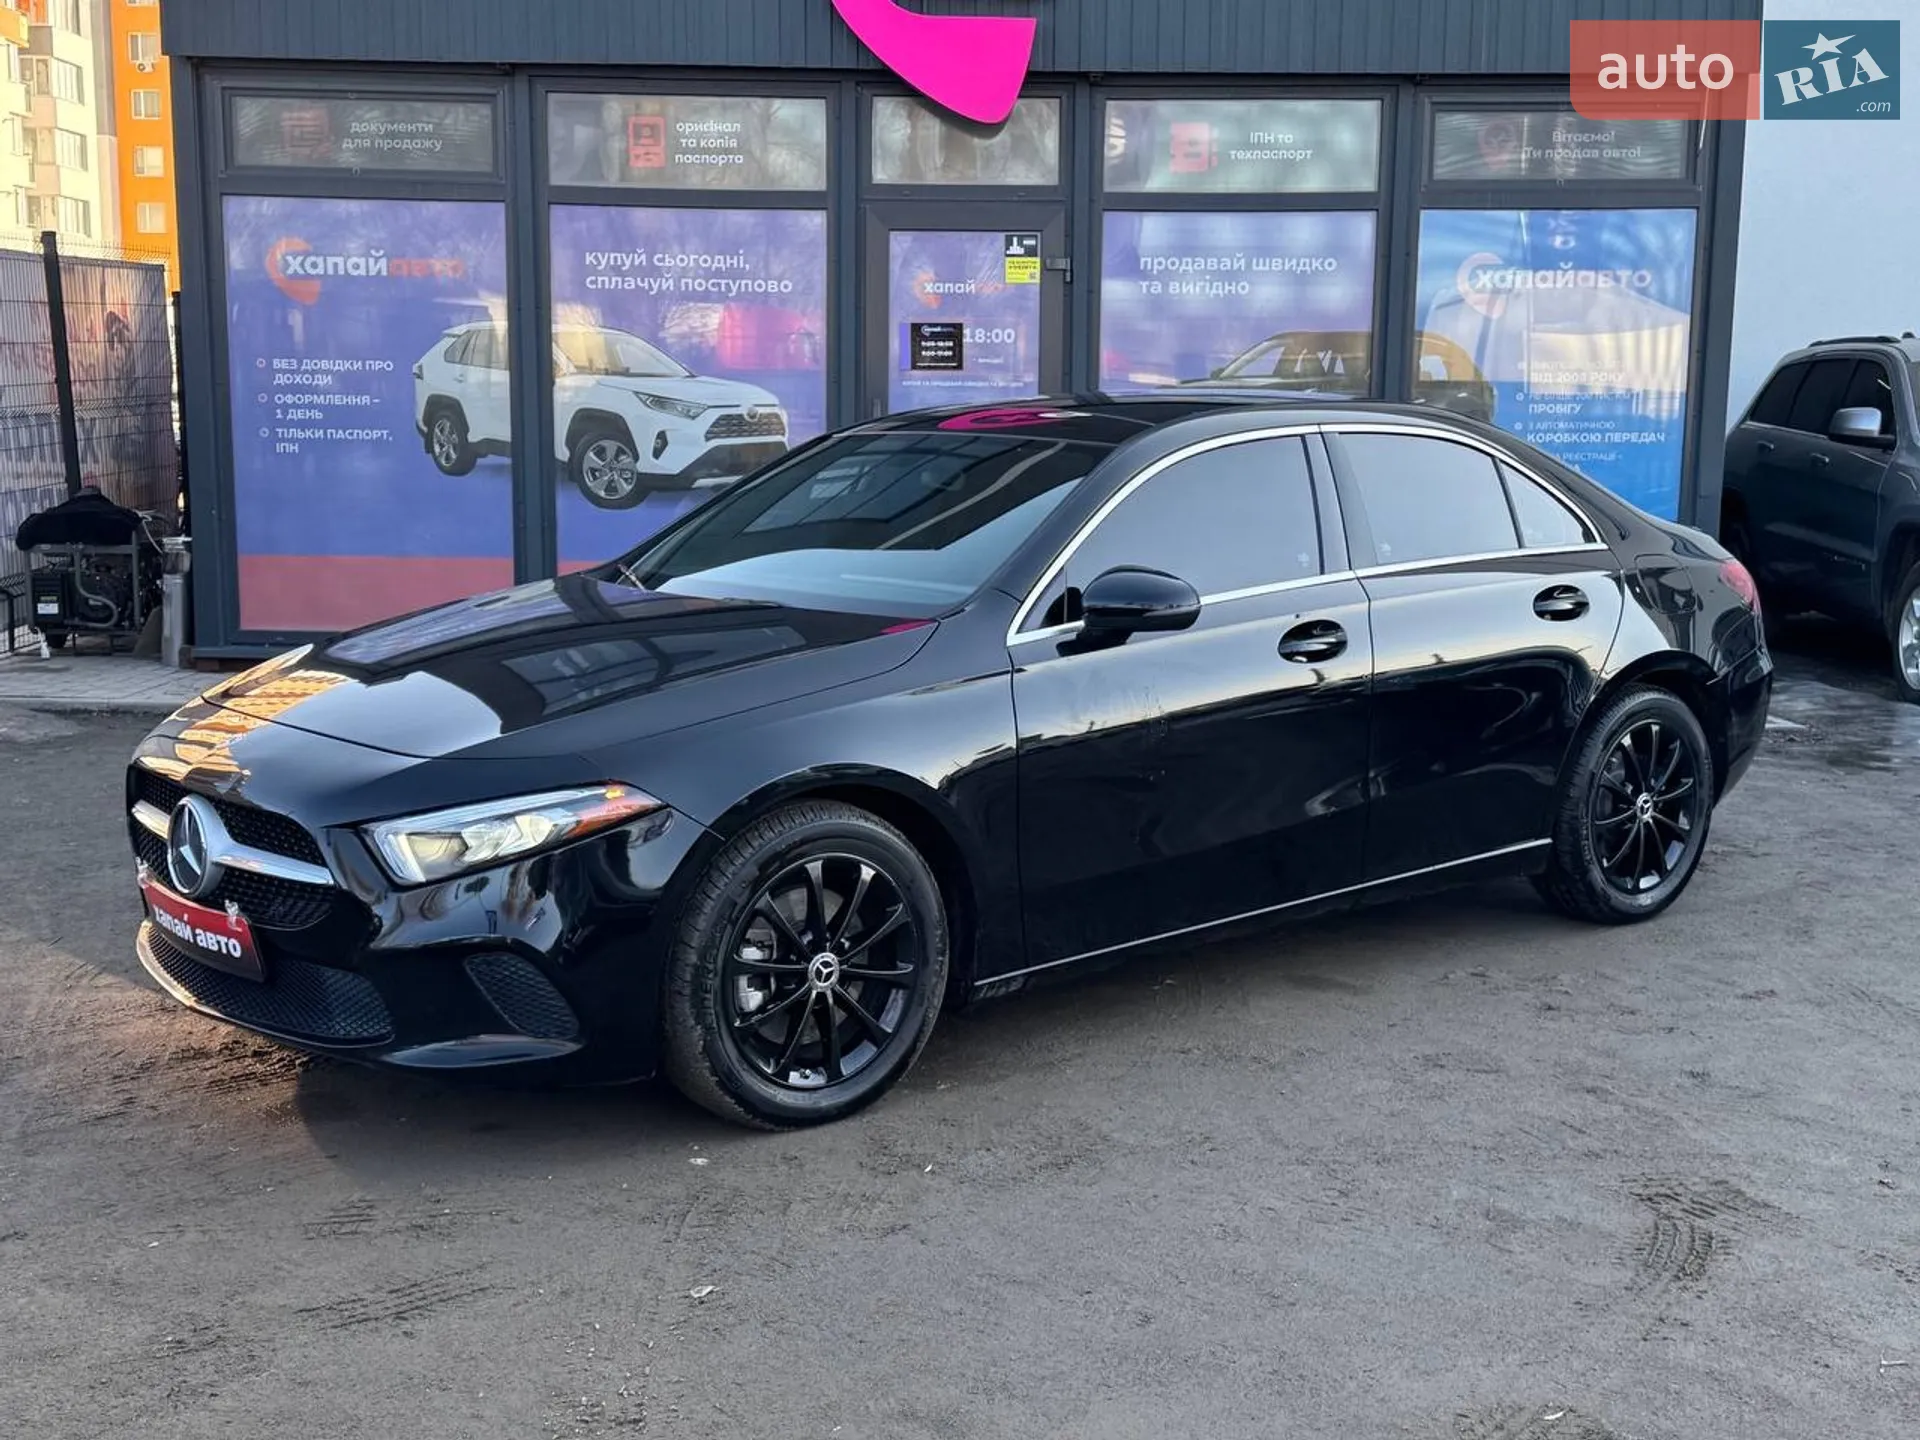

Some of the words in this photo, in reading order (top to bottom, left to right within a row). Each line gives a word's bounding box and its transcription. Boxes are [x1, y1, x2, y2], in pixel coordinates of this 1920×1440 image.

[349, 122, 435, 135] документи
[342, 138, 371, 150] для
[375, 138, 444, 152] продажу
[680, 138, 697, 148] та
[700, 136, 739, 149] копія
[1249, 131, 1275, 145] ІПН
[1277, 133, 1294, 144] та
[675, 154, 744, 167] паспорта
[1229, 149, 1314, 162] техпаспорт
[585, 248, 648, 271] купуй
[653, 249, 751, 272] сьогодні,
[1139, 252, 1246, 275] продавай
[1251, 256, 1339, 275] швидко
[585, 273, 675, 296] сплачуй
[680, 277, 793, 297] поступово
[923, 279, 1004, 294] хапай
[1139, 280, 1163, 294] та
[1168, 276, 1251, 298] вигідно
[963, 328, 1015, 344] 18:00
[272, 358, 298, 370] БЕЗ
[300, 359, 363, 373] ДОВІДКИ
[365, 360, 394, 372] ПРО
[273, 373, 333, 386] ДОХОДИ
[274, 394, 371, 406] ОФОРМЛЕННЯ
[275, 408, 285, 420] 1
[286, 408, 324, 421] ДЕНЬ
[1528, 403, 1583, 415] ПРОБІГУ
[275, 427, 324, 440] ТІЛЬКИ
[1527, 431, 1602, 444] КОРОБКОЮ
[1604, 432, 1666, 446] ПЕРЕДАЧ
[275, 442, 299, 454] ІПН
[194, 927, 242, 958] авто
